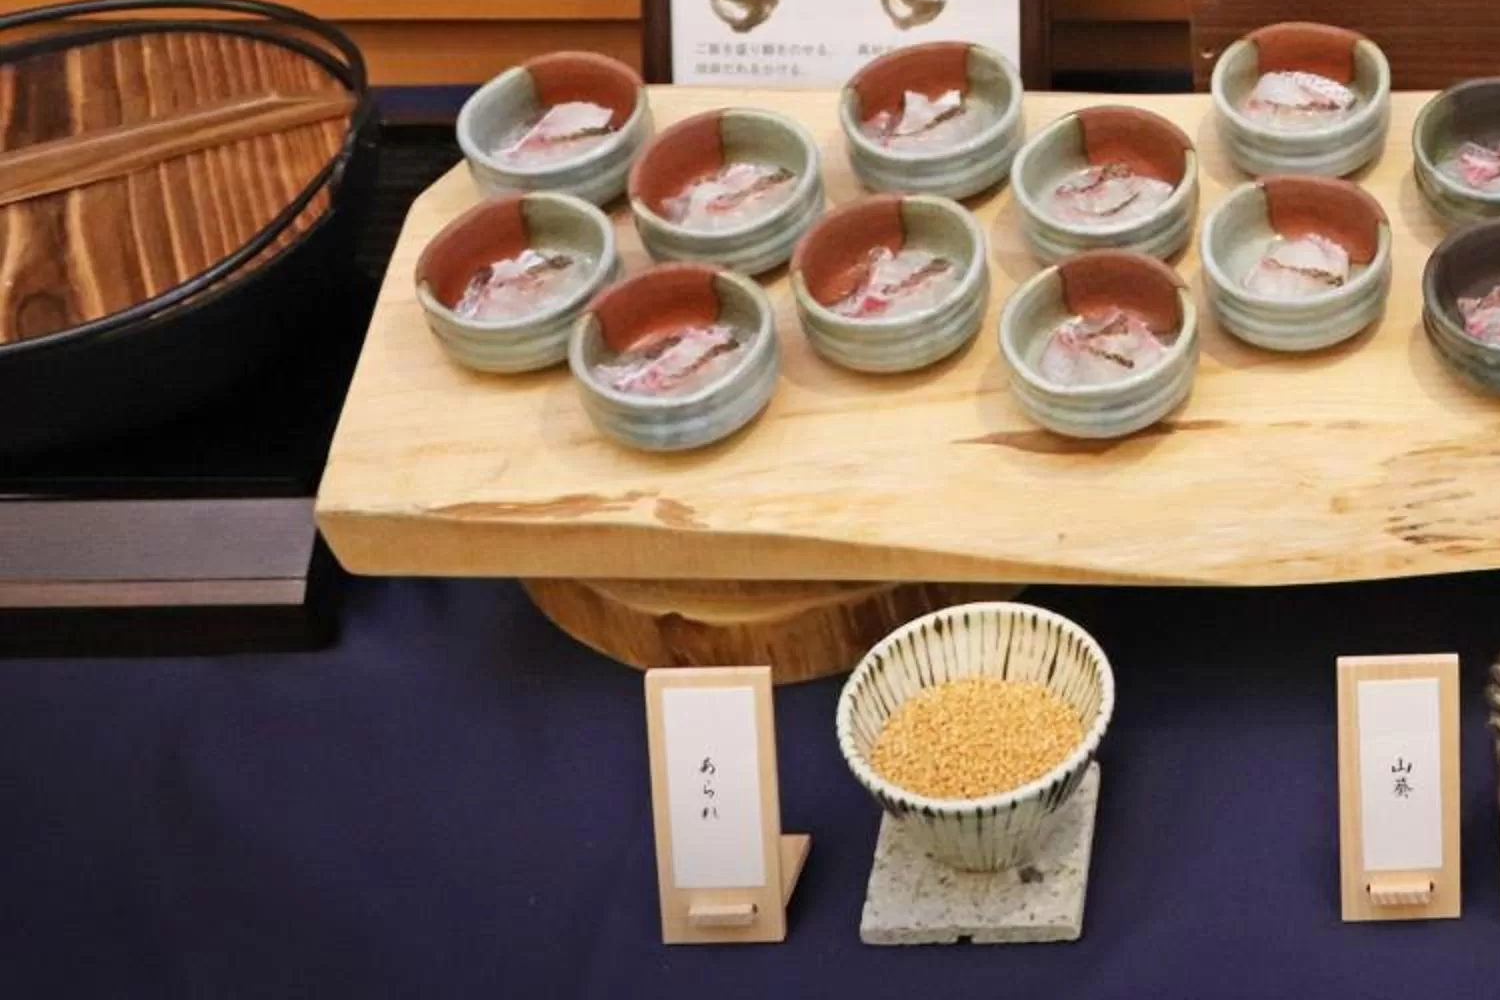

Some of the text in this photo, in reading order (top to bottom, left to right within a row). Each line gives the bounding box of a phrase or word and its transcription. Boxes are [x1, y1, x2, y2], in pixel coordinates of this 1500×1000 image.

[700, 757, 720, 820] あられ
[1391, 757, 1414, 800] 山葵
